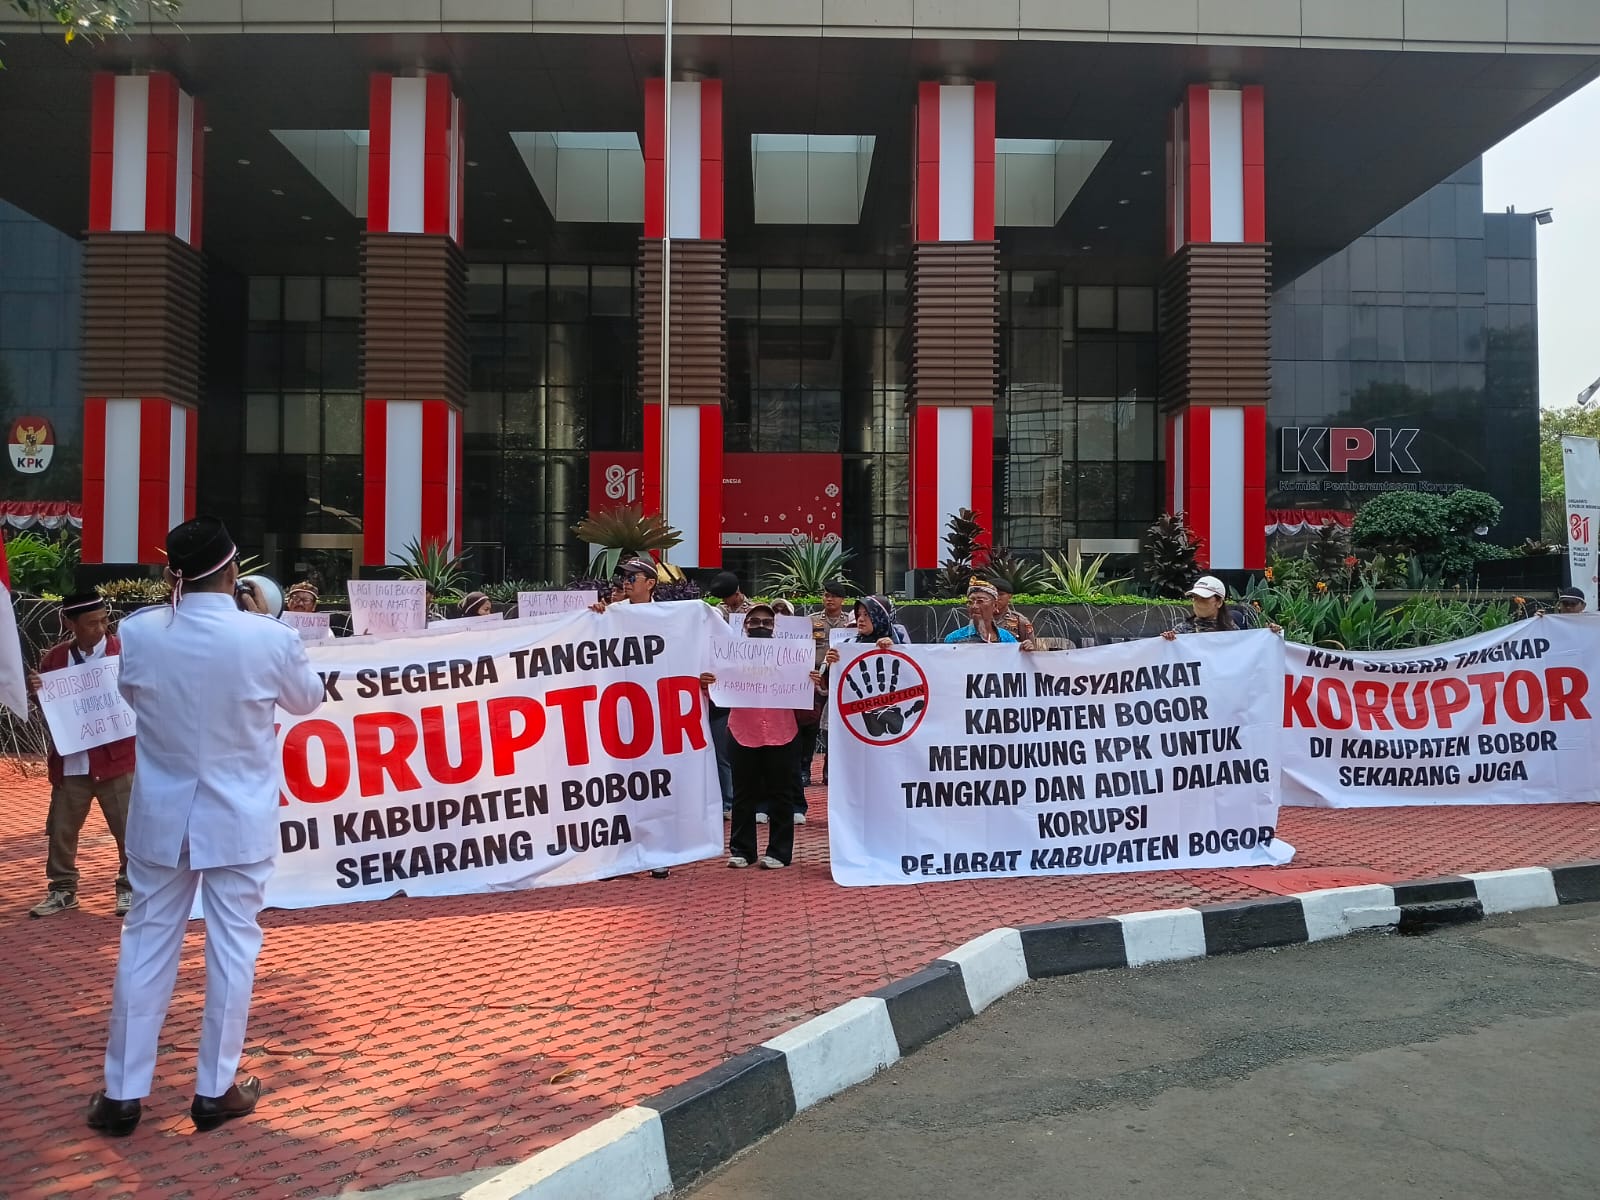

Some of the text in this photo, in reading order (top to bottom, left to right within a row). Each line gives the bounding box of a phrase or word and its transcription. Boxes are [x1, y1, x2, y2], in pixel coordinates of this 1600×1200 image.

[17, 457, 44, 469] KPK
[1281, 427, 1422, 473] KPK
[605, 464, 639, 503] 81
[1569, 513, 1590, 545] 81
[356, 655, 499, 699] SEGERA
[509, 634, 665, 679] TANGKAP
[1306, 649, 1354, 671] KPK
[1454, 638, 1550, 669] TANGKAP
[41, 664, 119, 702] KORUPT
[724, 682, 768, 694] KABUPATEN
[850, 686, 925, 711] CORRUPTION
[965, 661, 1202, 699] KAMI MASYARAKAT
[1283, 667, 1592, 730] KORUPTOR
[965, 695, 1209, 734] KABUPATEN BOGOR
[274, 676, 707, 806] ORUPTOR
[928, 726, 1242, 772] MENDUKUNG KPK UNTUK
[1310, 730, 1558, 759] DI KABUPATEN BOBOR
[901, 758, 1270, 809] TANGKAP DAN ADILI DALANG
[1339, 760, 1528, 787] SEKARANG JUGA
[280, 768, 672, 853] DI KABUPATEN BOBOR
[1038, 805, 1148, 839] KORUPSI
[335, 814, 632, 889] SEKARANG JUGA
[1030, 834, 1179, 870] KABUPATEN
[1189, 826, 1275, 857] BOGOR
